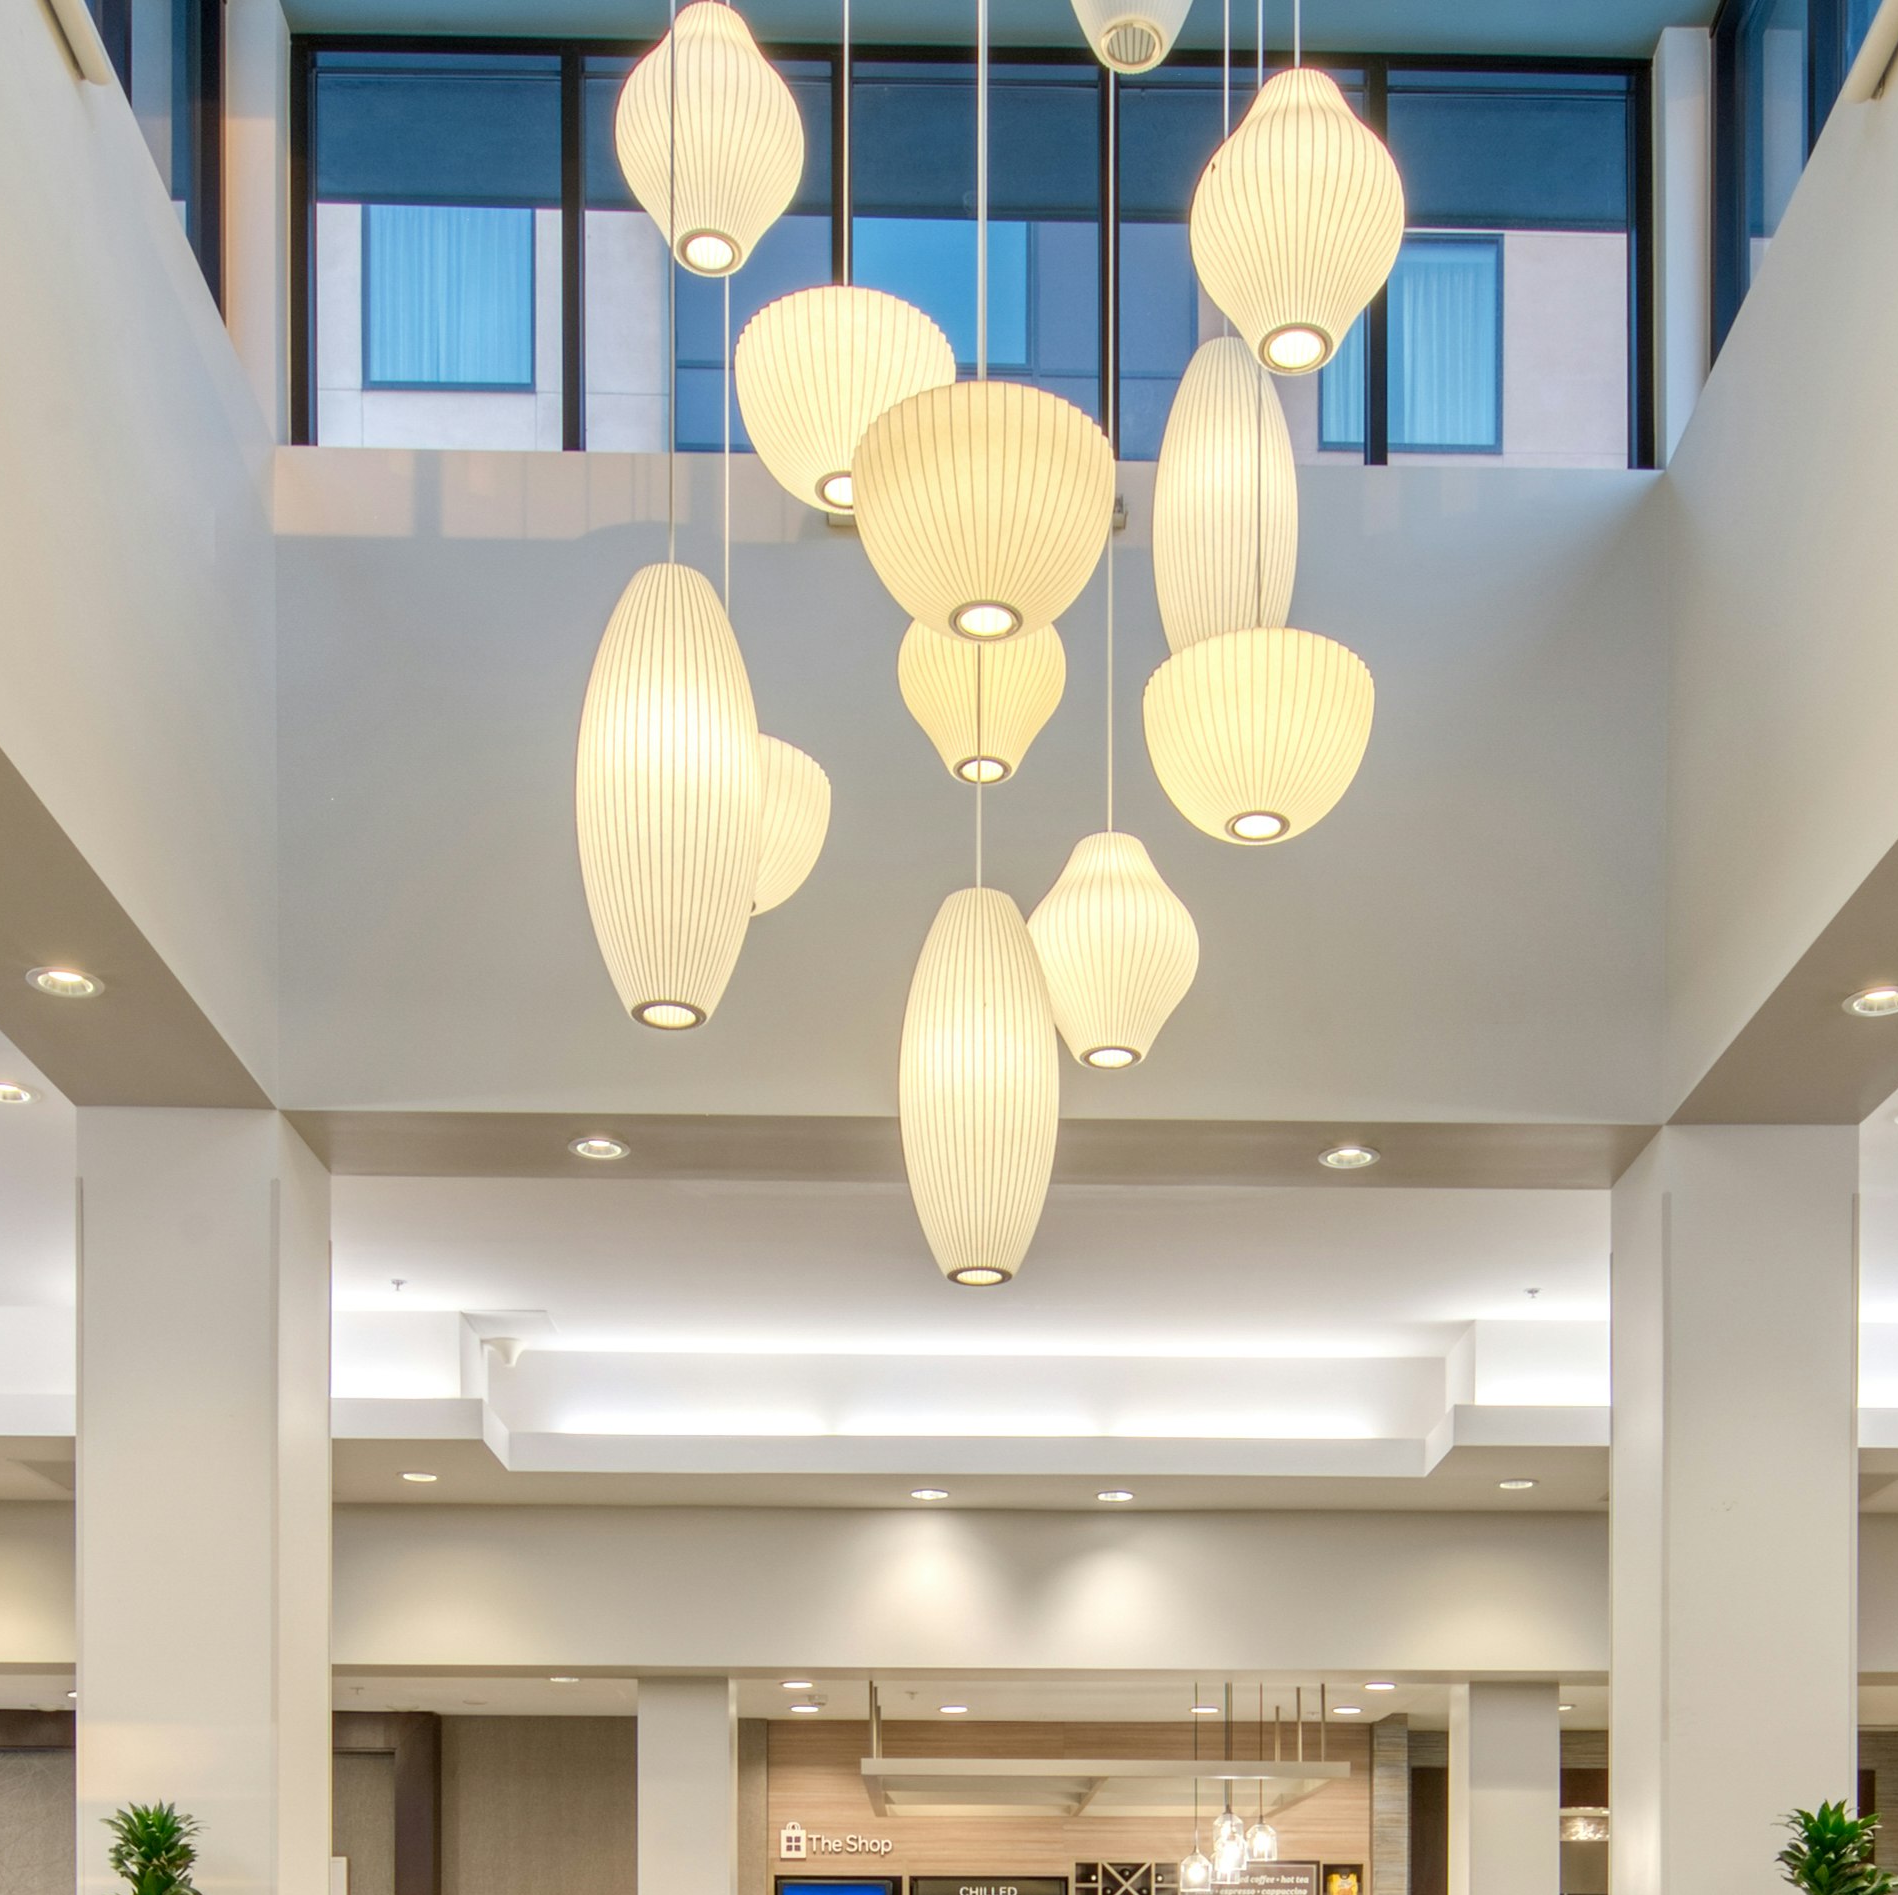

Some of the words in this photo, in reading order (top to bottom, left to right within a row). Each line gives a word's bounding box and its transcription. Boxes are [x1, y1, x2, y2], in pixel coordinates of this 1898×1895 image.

[808, 1834, 843, 1853] The
[845, 1834, 893, 1856] Shop
[1250, 1875, 1276, 1886] coffee
[1281, 1875, 1295, 1884] hot
[1296, 1876, 1310, 1884] tea
